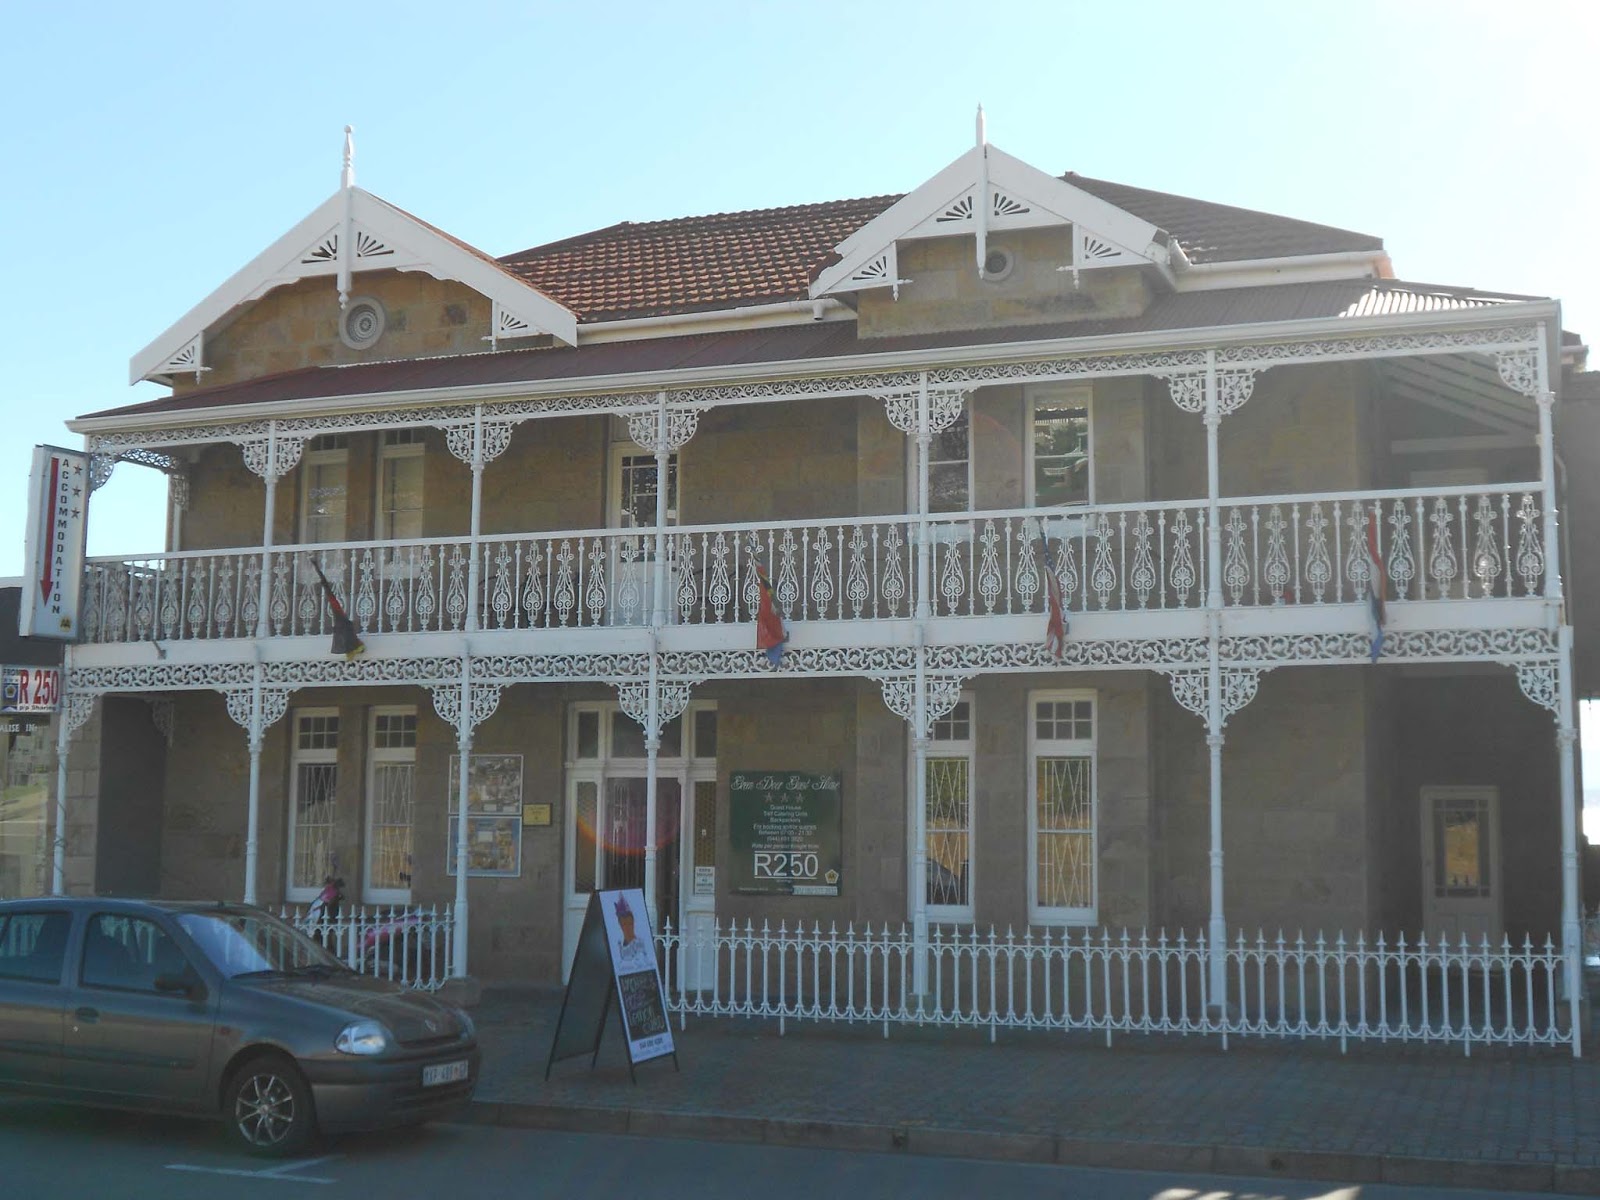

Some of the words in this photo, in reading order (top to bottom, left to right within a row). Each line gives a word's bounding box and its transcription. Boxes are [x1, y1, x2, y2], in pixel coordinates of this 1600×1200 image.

[52, 458, 70, 615] ACCOMMODATION
[19, 669, 30, 704] R
[33, 669, 59, 705] 250
[754, 854, 819, 877] R250
